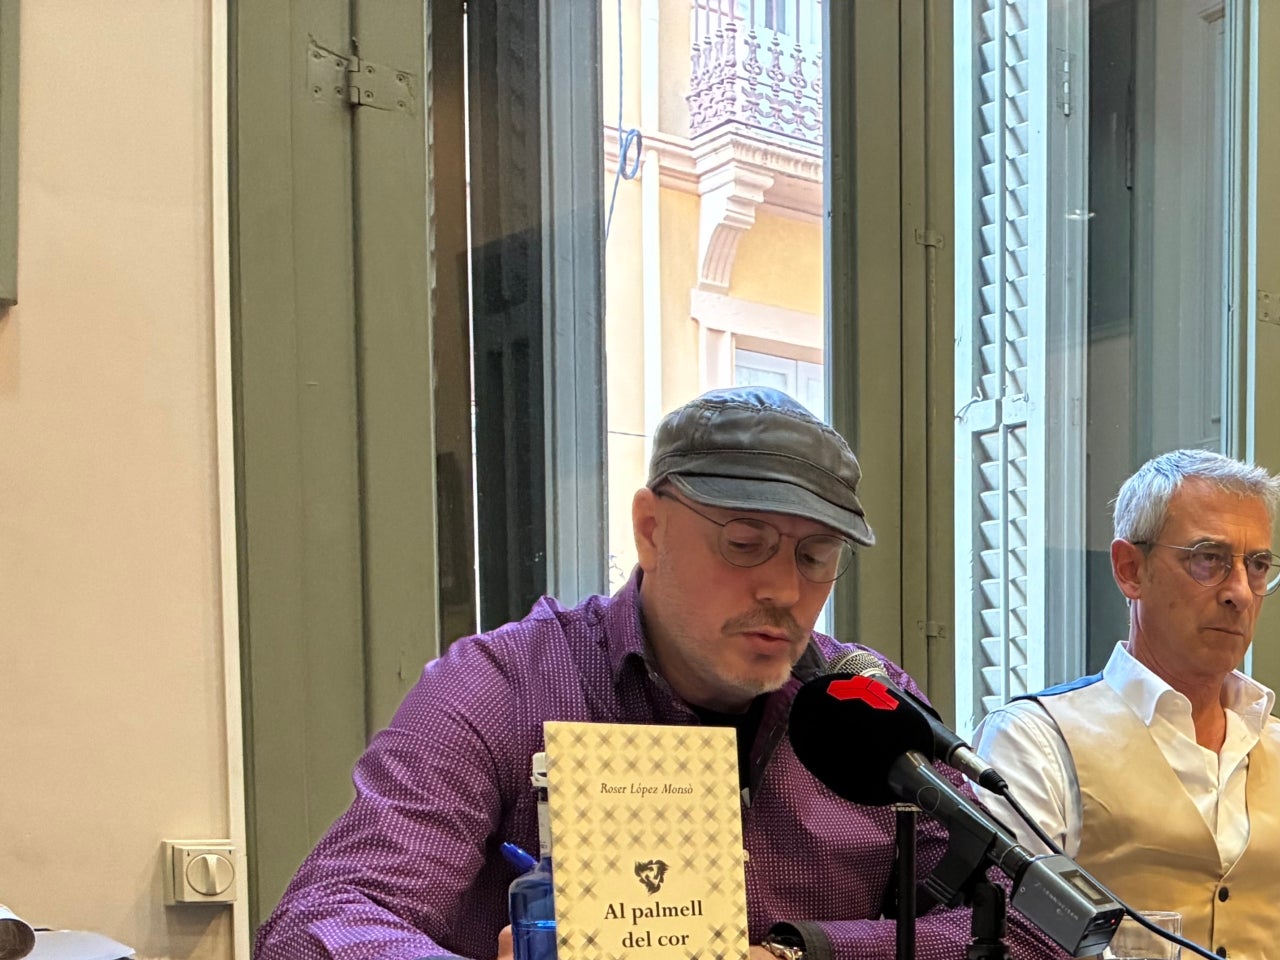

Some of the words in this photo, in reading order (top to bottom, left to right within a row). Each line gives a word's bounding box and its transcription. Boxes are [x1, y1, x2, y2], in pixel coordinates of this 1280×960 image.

[600, 782, 627, 794] Roser
[630, 782, 658, 798] López
[661, 782, 693, 795] Monsò
[604, 902, 626, 919] Al
[632, 900, 703, 925] palmell
[621, 931, 652, 948] del
[658, 933, 690, 947] cor
